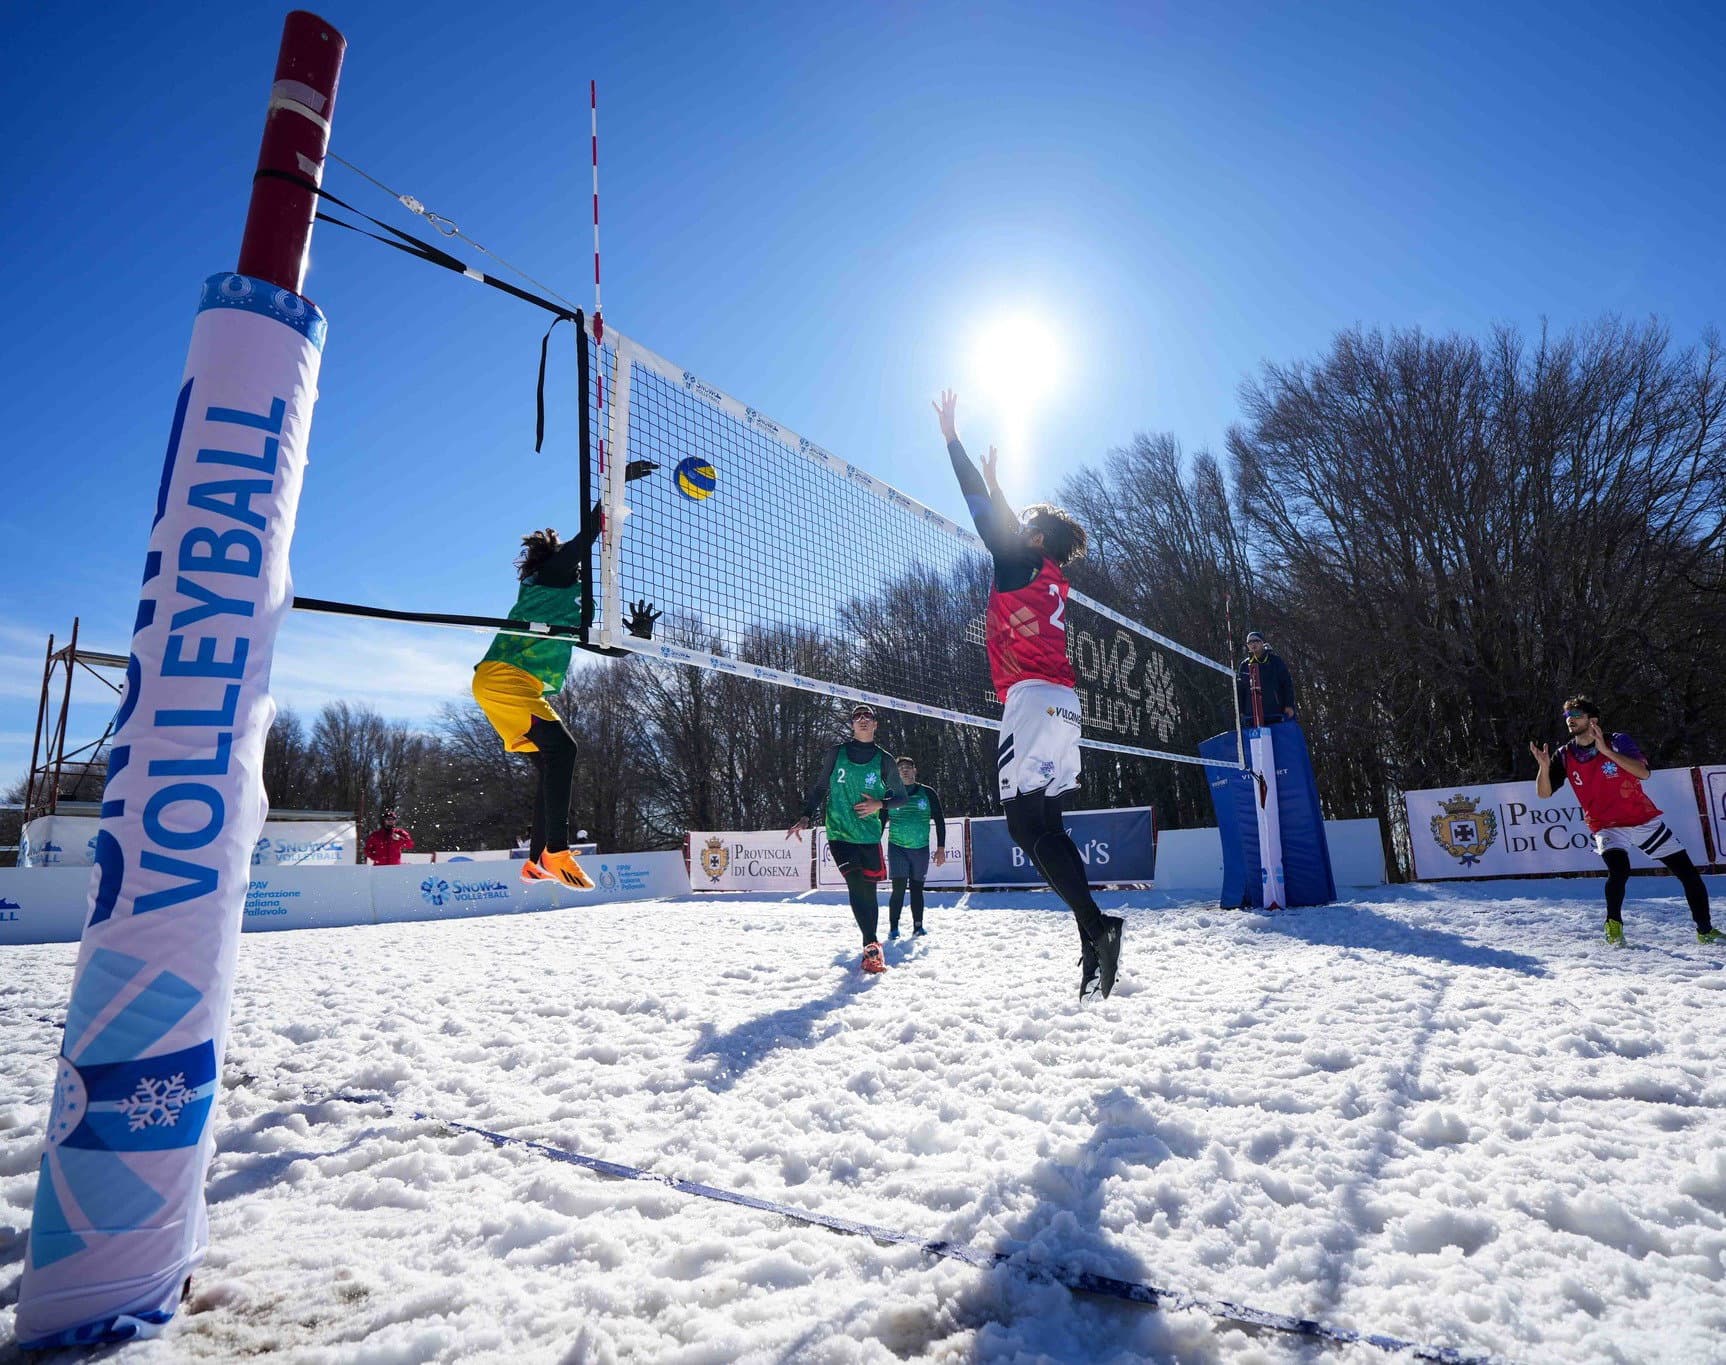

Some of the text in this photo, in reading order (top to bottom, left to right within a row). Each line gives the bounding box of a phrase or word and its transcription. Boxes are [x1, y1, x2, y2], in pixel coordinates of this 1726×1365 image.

[1048, 584, 1065, 630] 2
[132, 395, 287, 916] VOLLEYBALL
[837, 768, 846, 783] 2
[1573, 771, 1583, 785] 3
[1507, 803, 1585, 825] PROVI
[1512, 836, 1537, 852] DI
[735, 844, 792, 860] PROVINCIA
[734, 860, 800, 877] DI COSENZA
[249, 881, 269, 890] PAV
[452, 880, 490, 894] SNOW
[246, 890, 301, 899] ederazione
[454, 891, 509, 901] VOLLEYBALL
[245, 899, 281, 908] taliana
